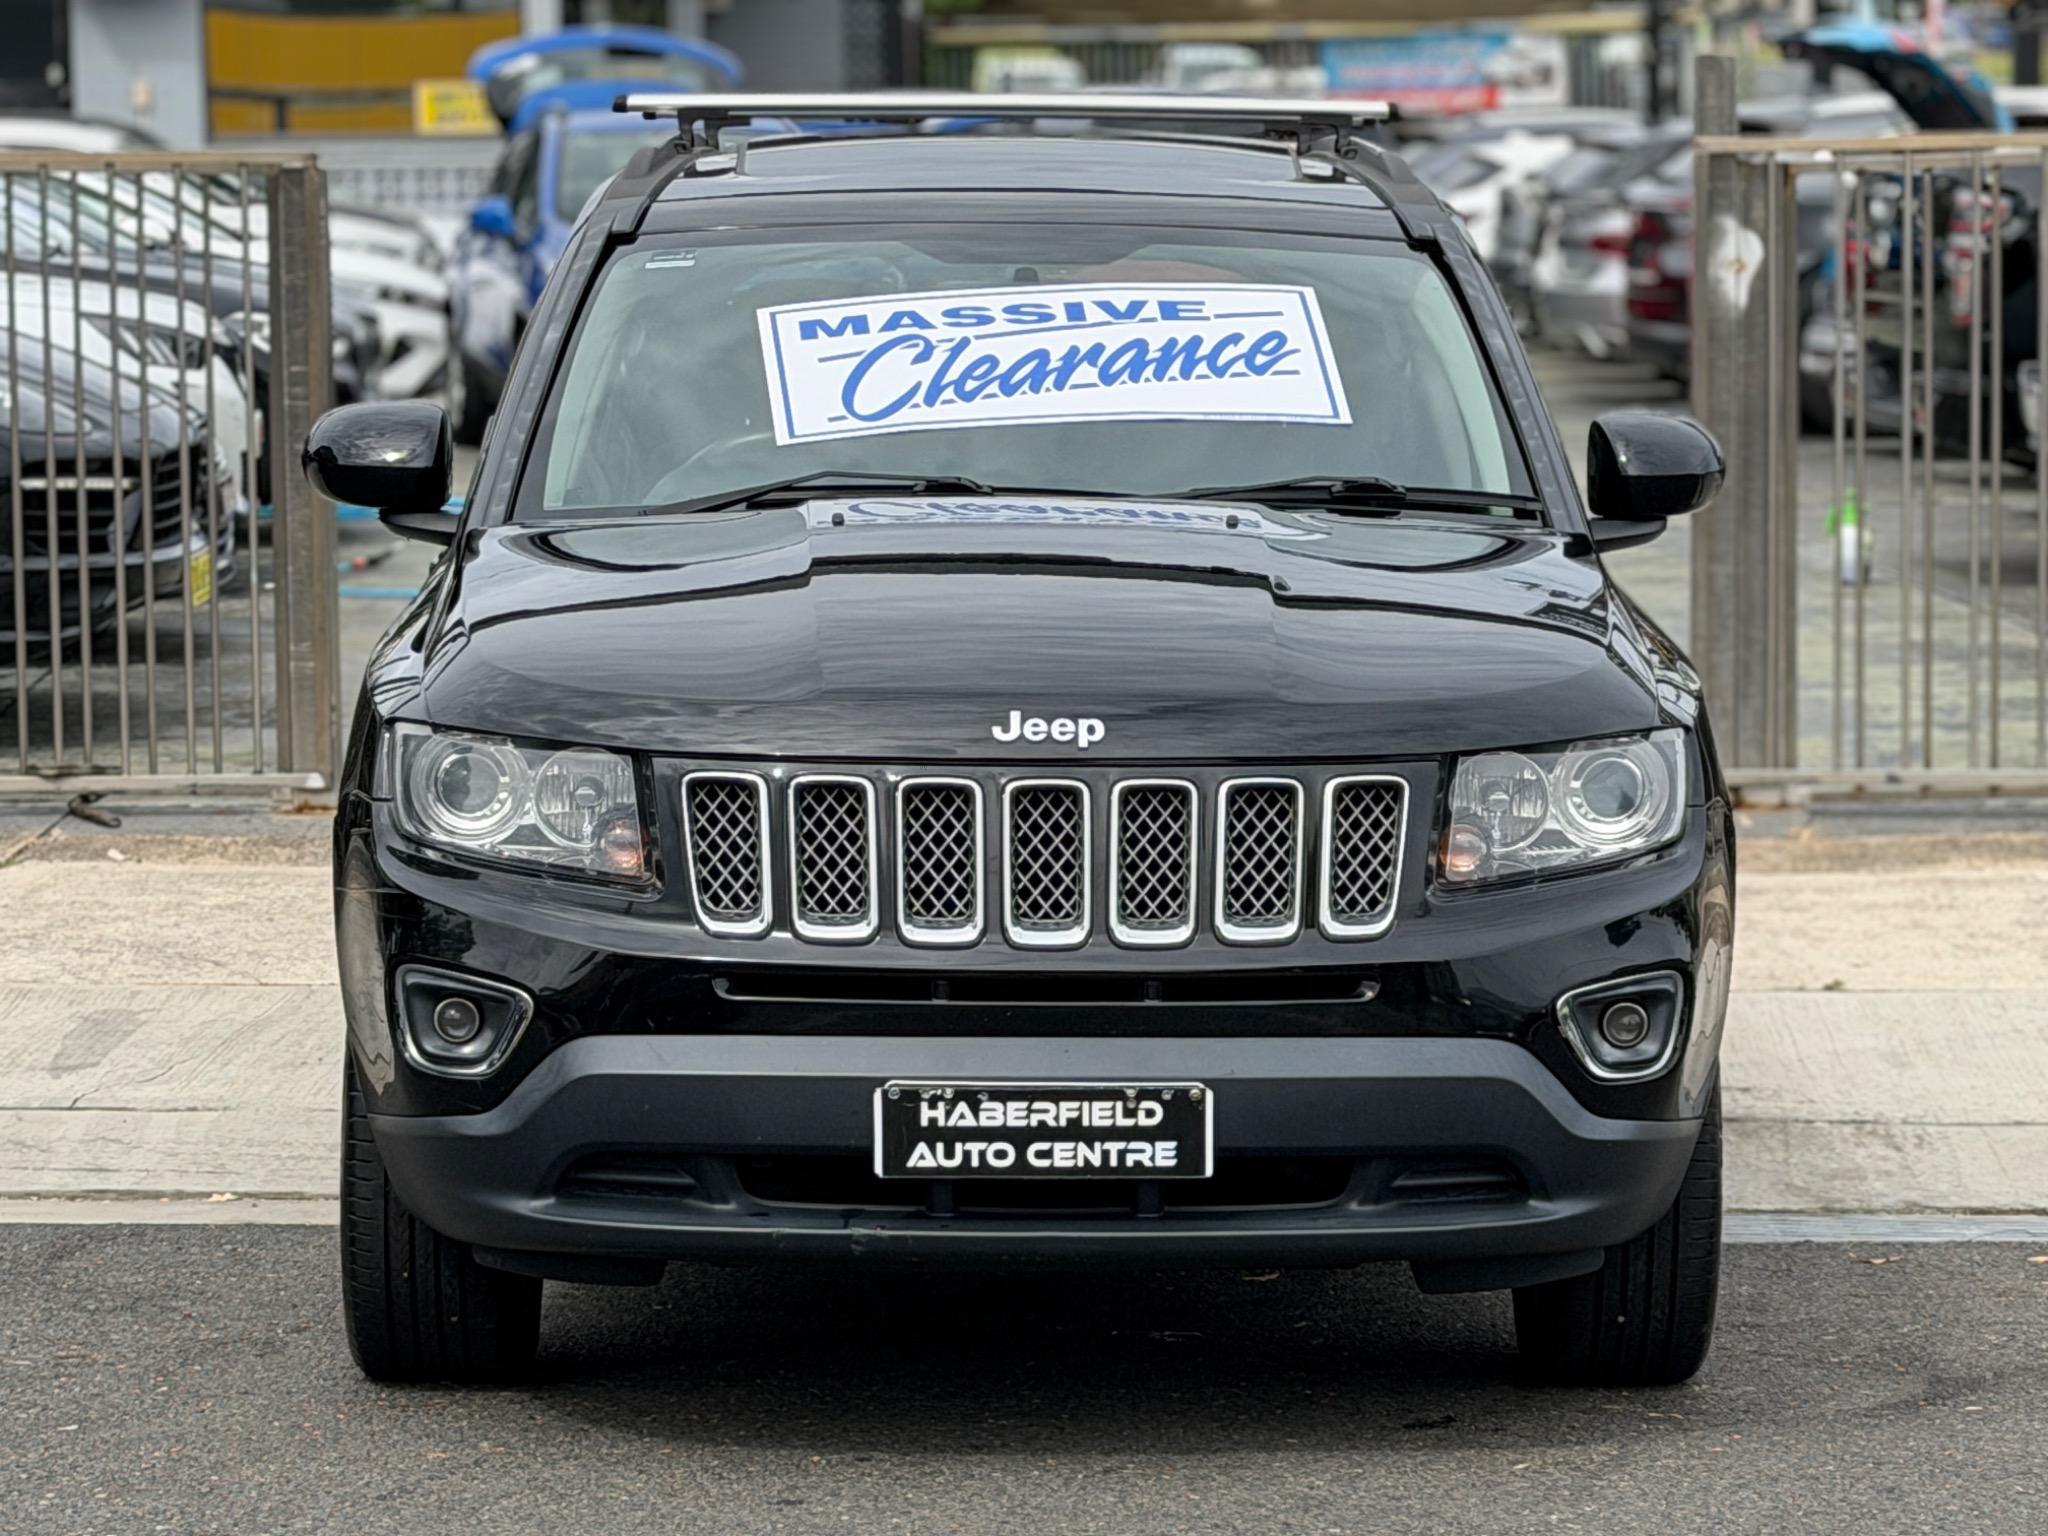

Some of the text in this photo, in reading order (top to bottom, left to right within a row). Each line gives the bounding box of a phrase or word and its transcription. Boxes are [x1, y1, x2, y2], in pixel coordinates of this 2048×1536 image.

[799, 300, 1207, 340] MASSIVE
[841, 330, 1300, 422] Clearance
[991, 709, 1106, 748] Jeep
[920, 1101, 1164, 1127] HABERFIELD
[906, 1141, 1178, 1168] AUTO CENTRE
